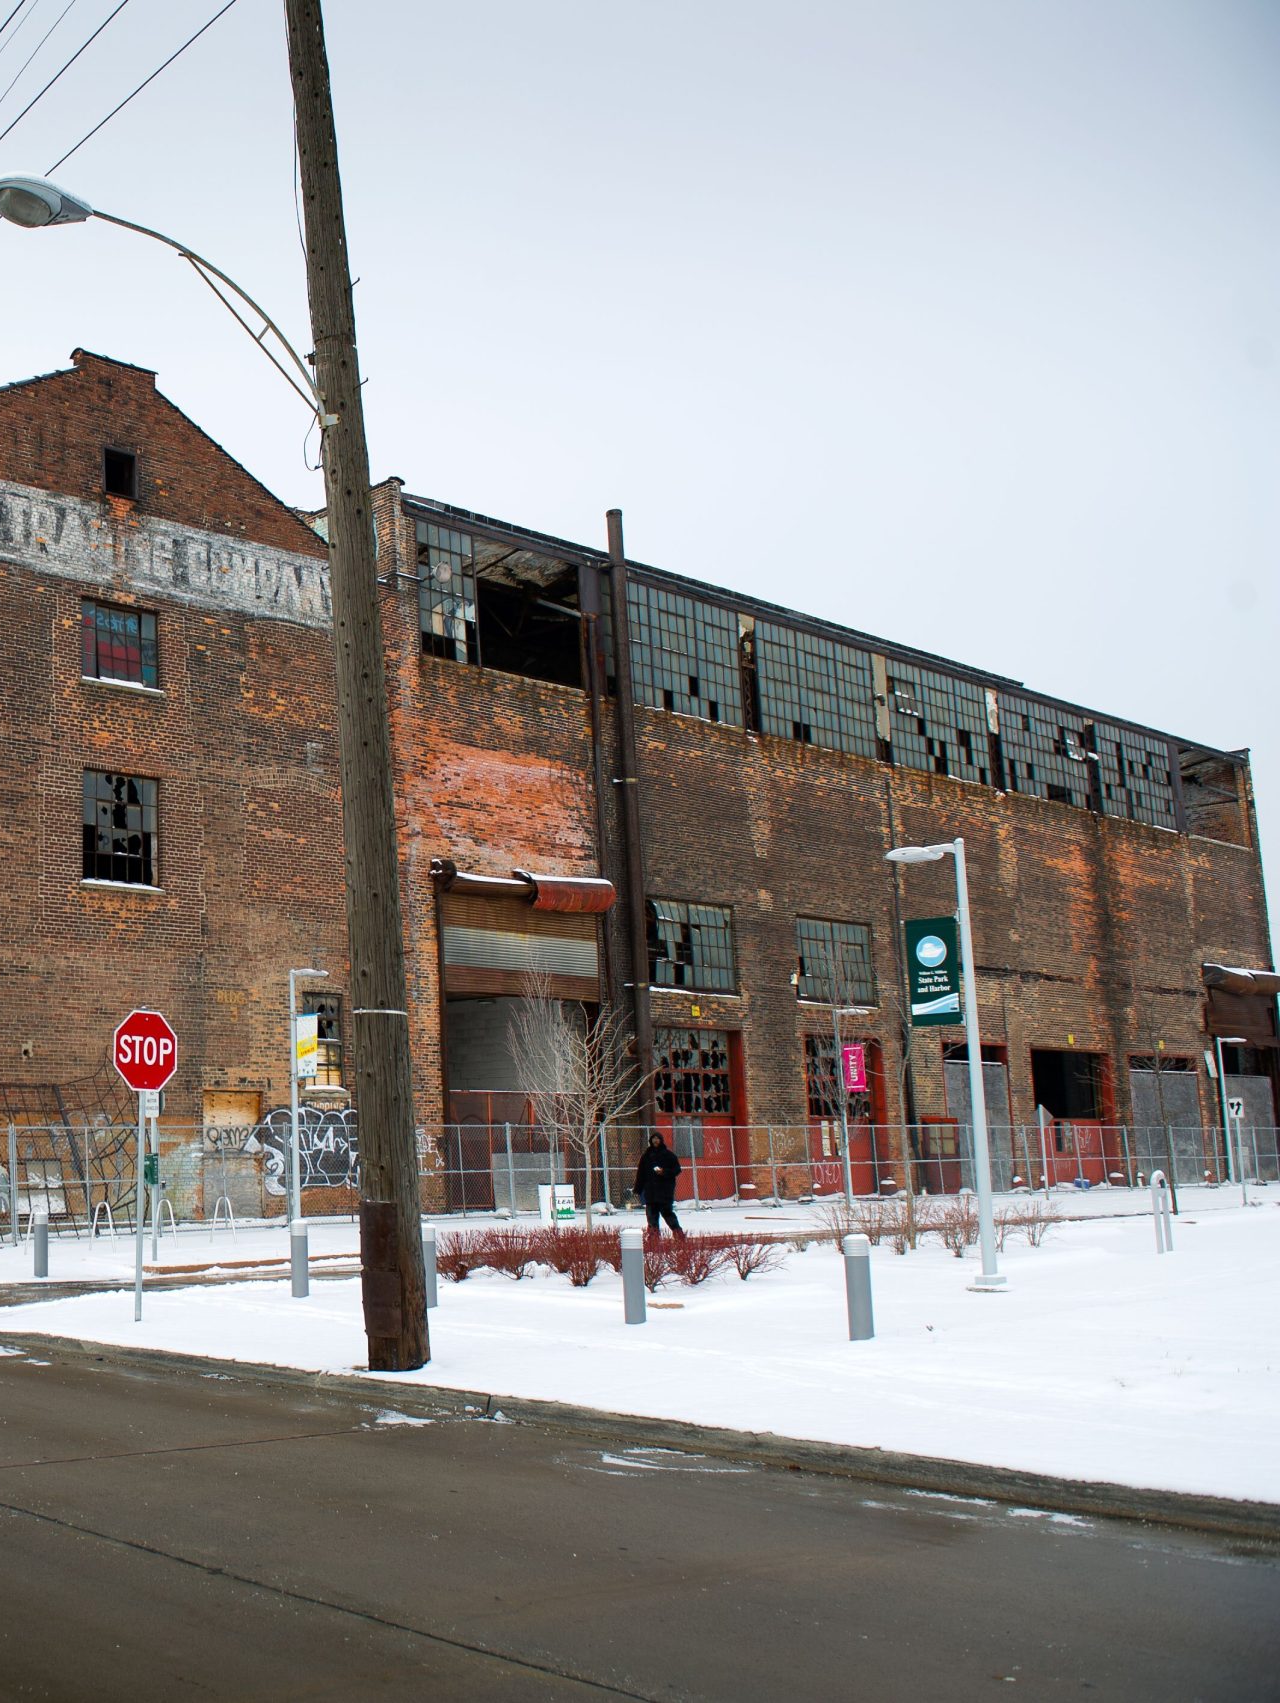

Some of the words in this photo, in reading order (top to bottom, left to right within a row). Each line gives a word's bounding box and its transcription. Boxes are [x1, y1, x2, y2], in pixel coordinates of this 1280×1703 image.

[187, 536, 331, 614] COMPAN
[917, 985, 929, 993] and
[918, 976, 933, 984] State
[934, 975, 949, 983] Park
[119, 1034, 173, 1067] STOP
[849, 1054, 859, 1082] UNITY
